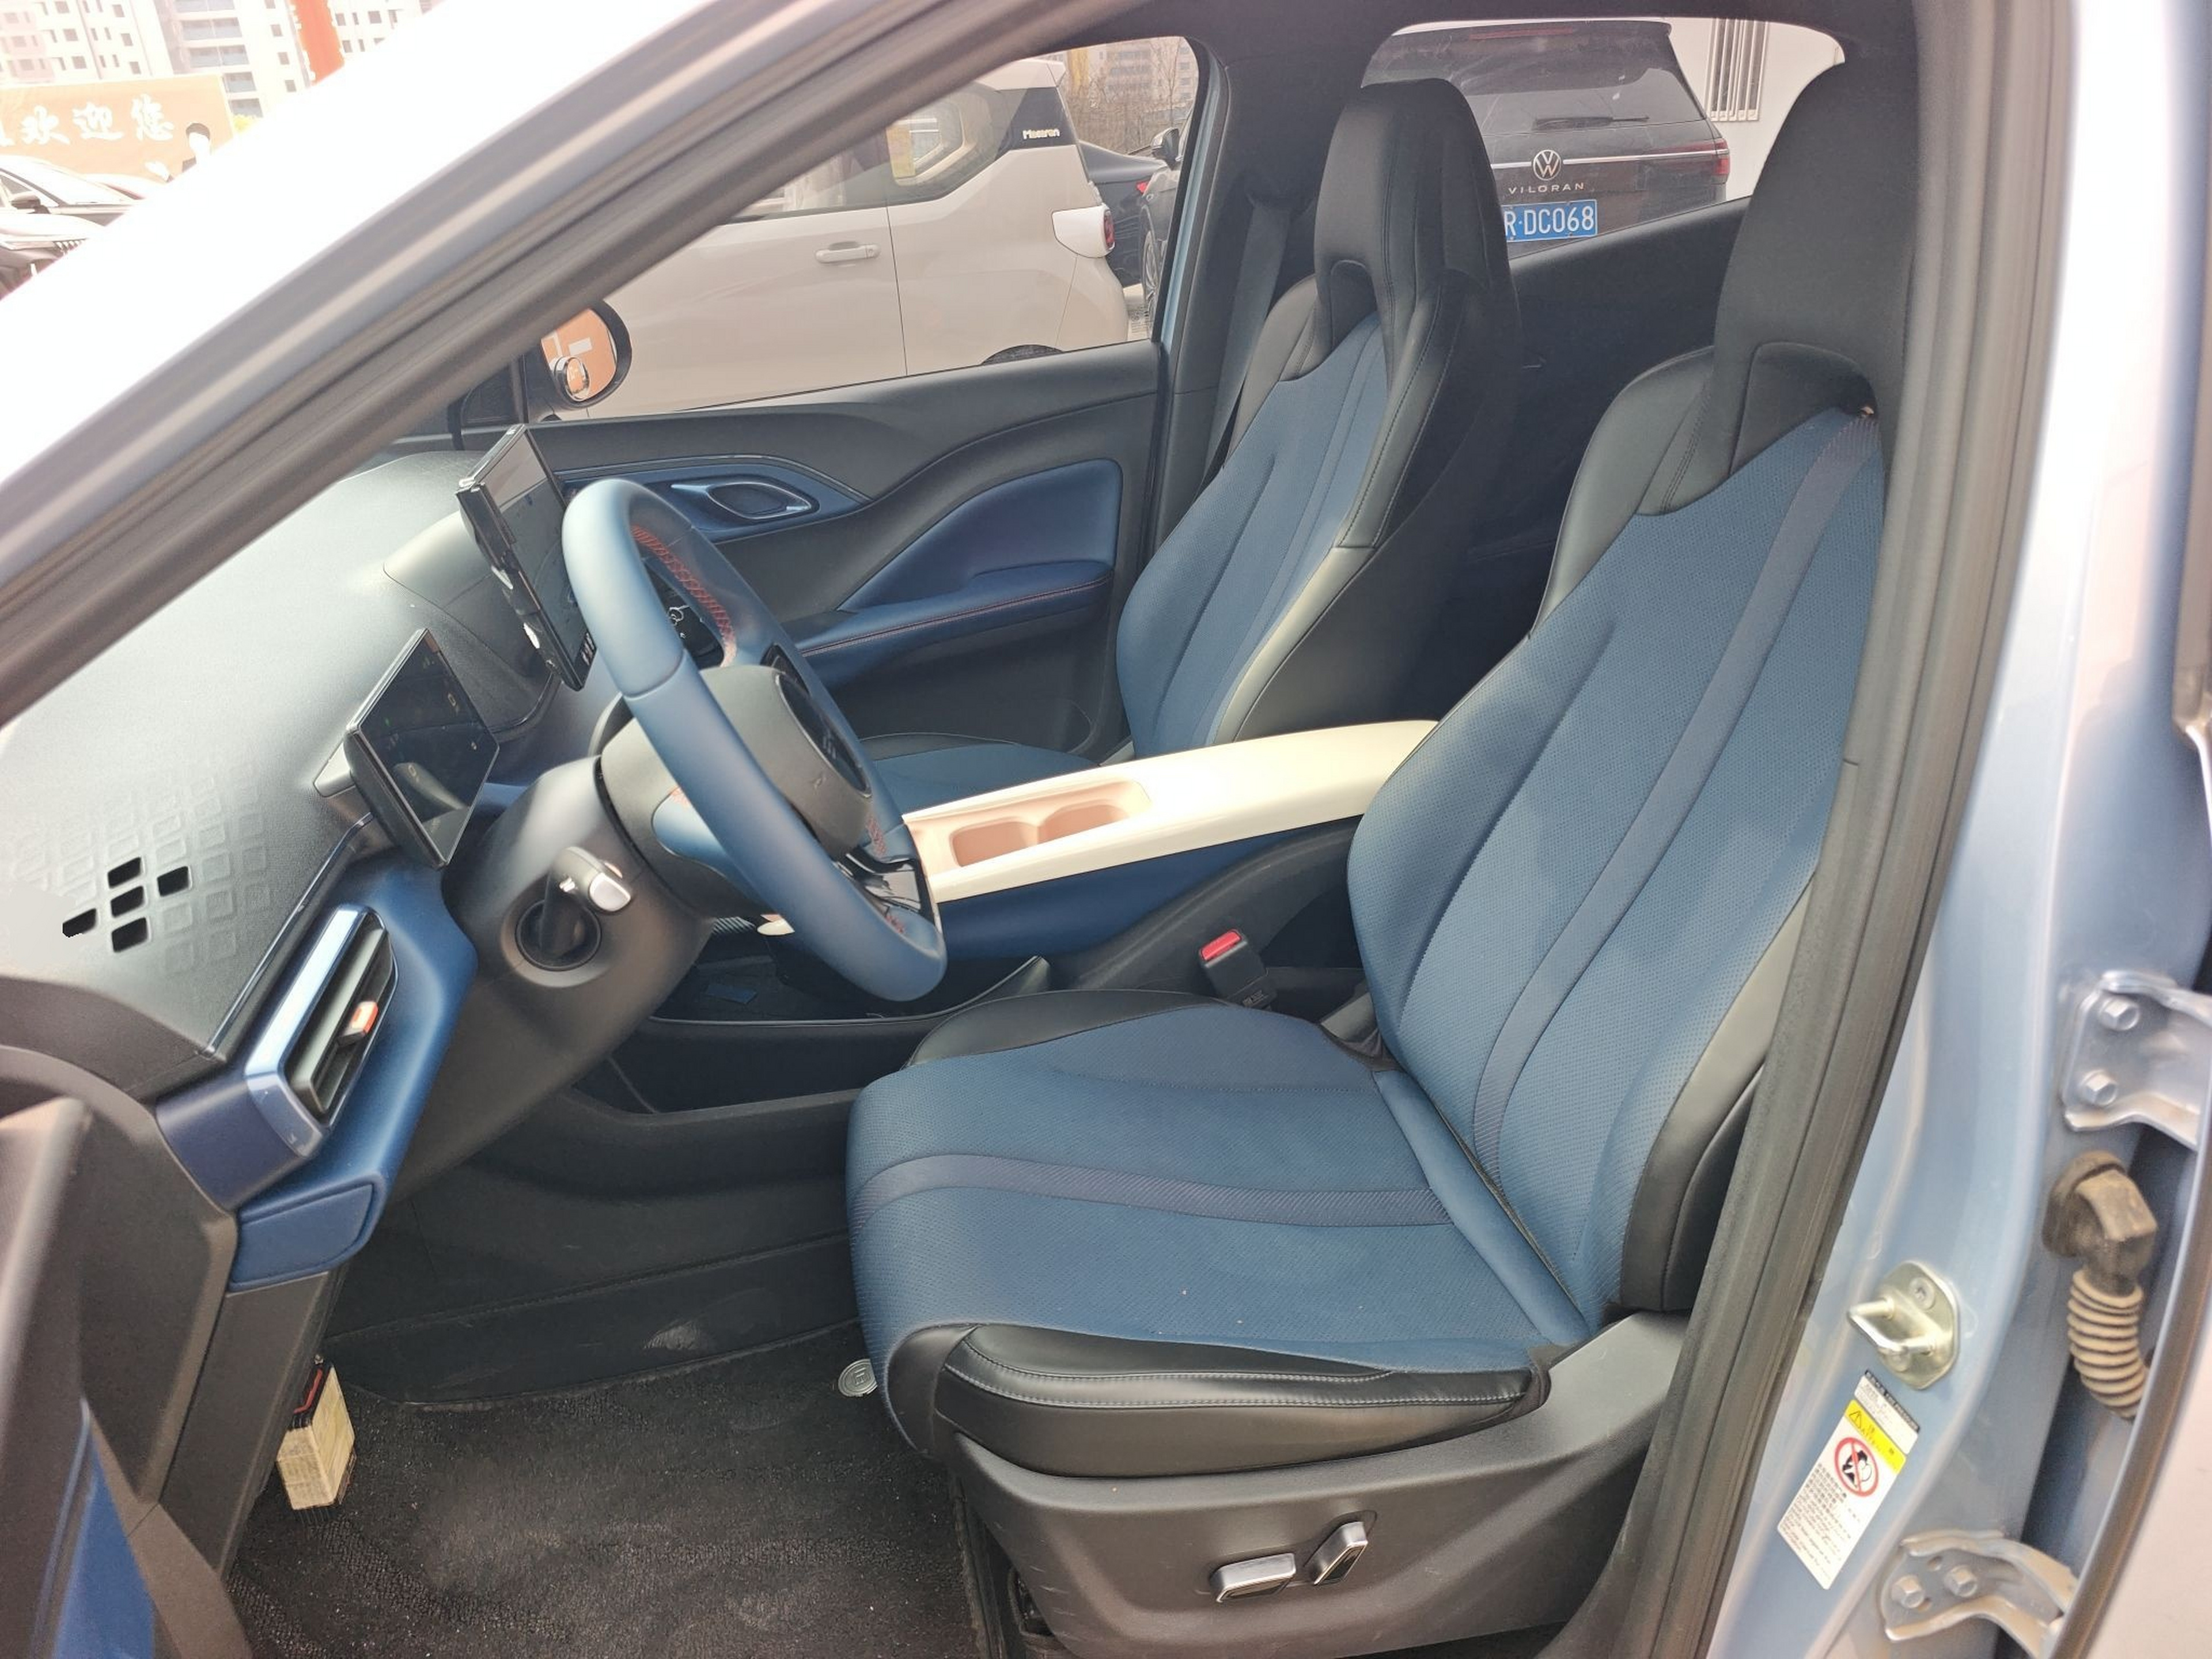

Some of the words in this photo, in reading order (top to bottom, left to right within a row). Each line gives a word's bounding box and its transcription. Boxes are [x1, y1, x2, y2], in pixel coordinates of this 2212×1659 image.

[0, 93, 175, 147] 欢迎您
[1508, 182, 1584, 195] VILORAN
